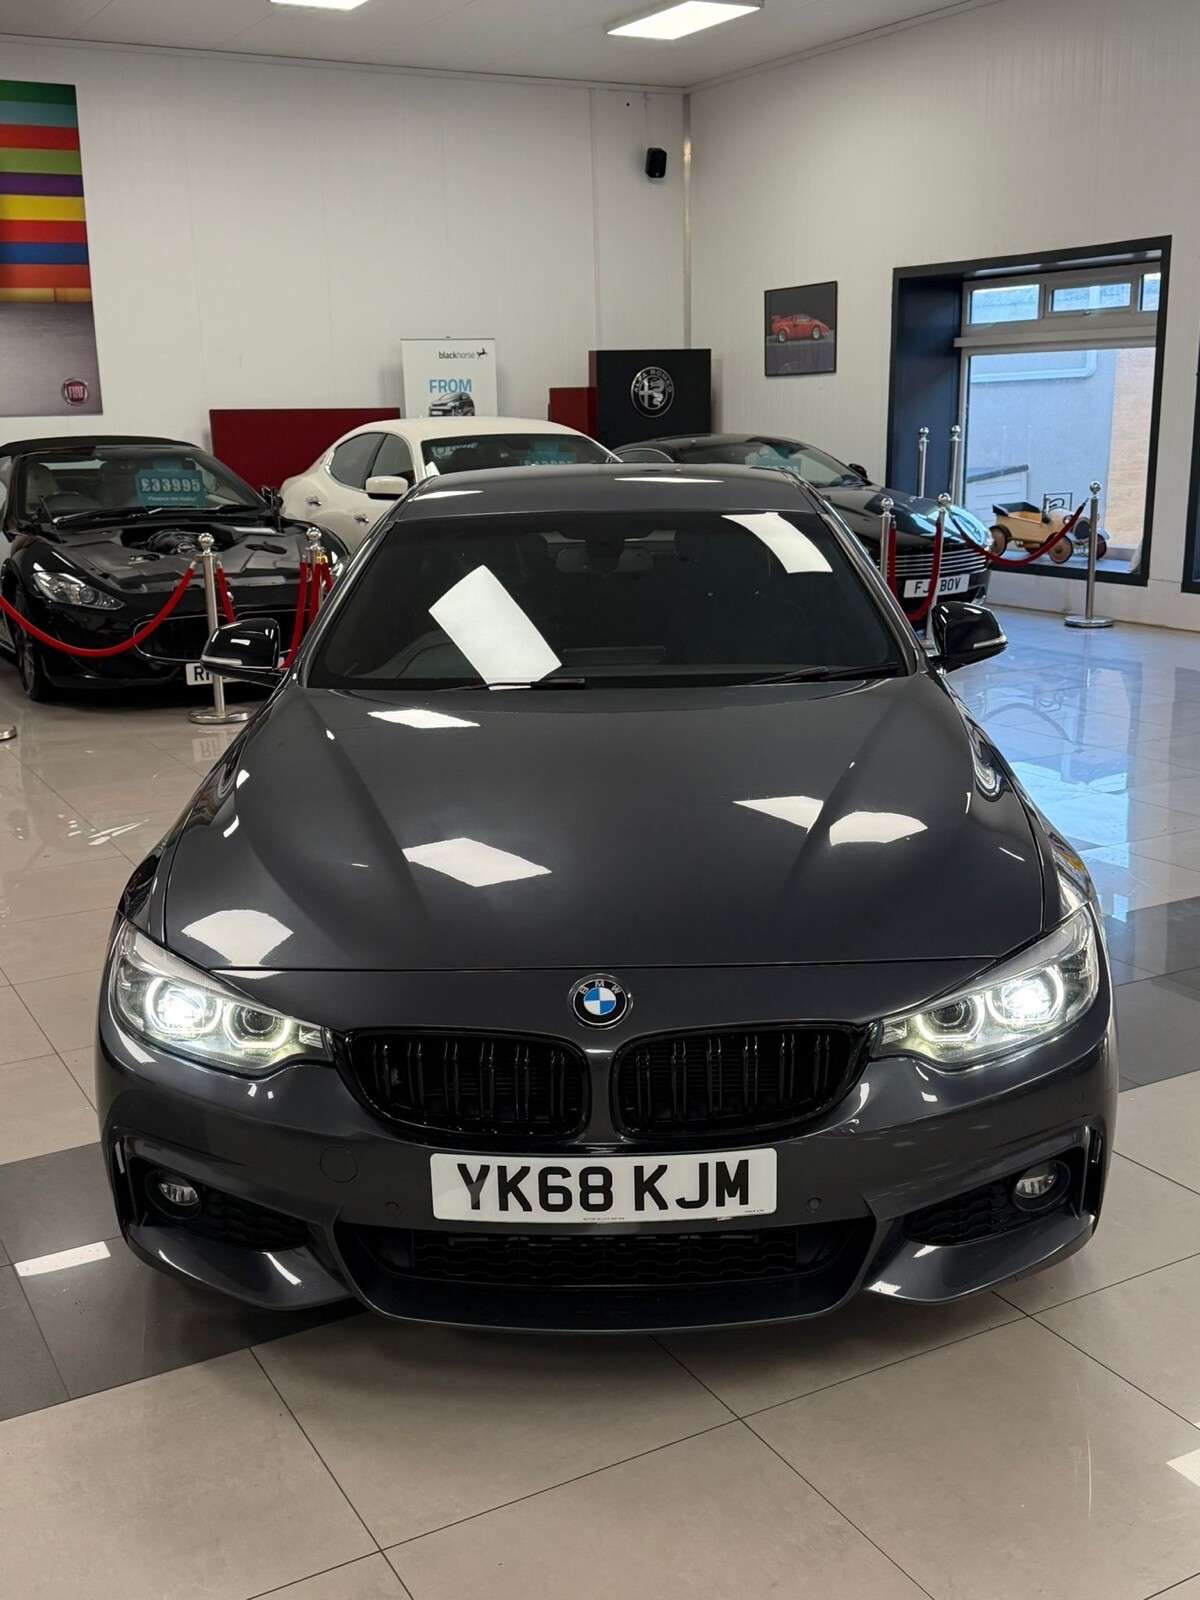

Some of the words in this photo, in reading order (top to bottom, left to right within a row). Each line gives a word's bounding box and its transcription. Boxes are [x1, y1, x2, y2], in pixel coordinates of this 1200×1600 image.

[438, 351, 475, 359] blackhorse
[429, 379, 472, 393] FROM
[141, 478, 200, 492] £33995
[579, 979, 622, 994] BMW
[457, 1163, 613, 1212] YK68
[634, 1159, 749, 1211] KJM
